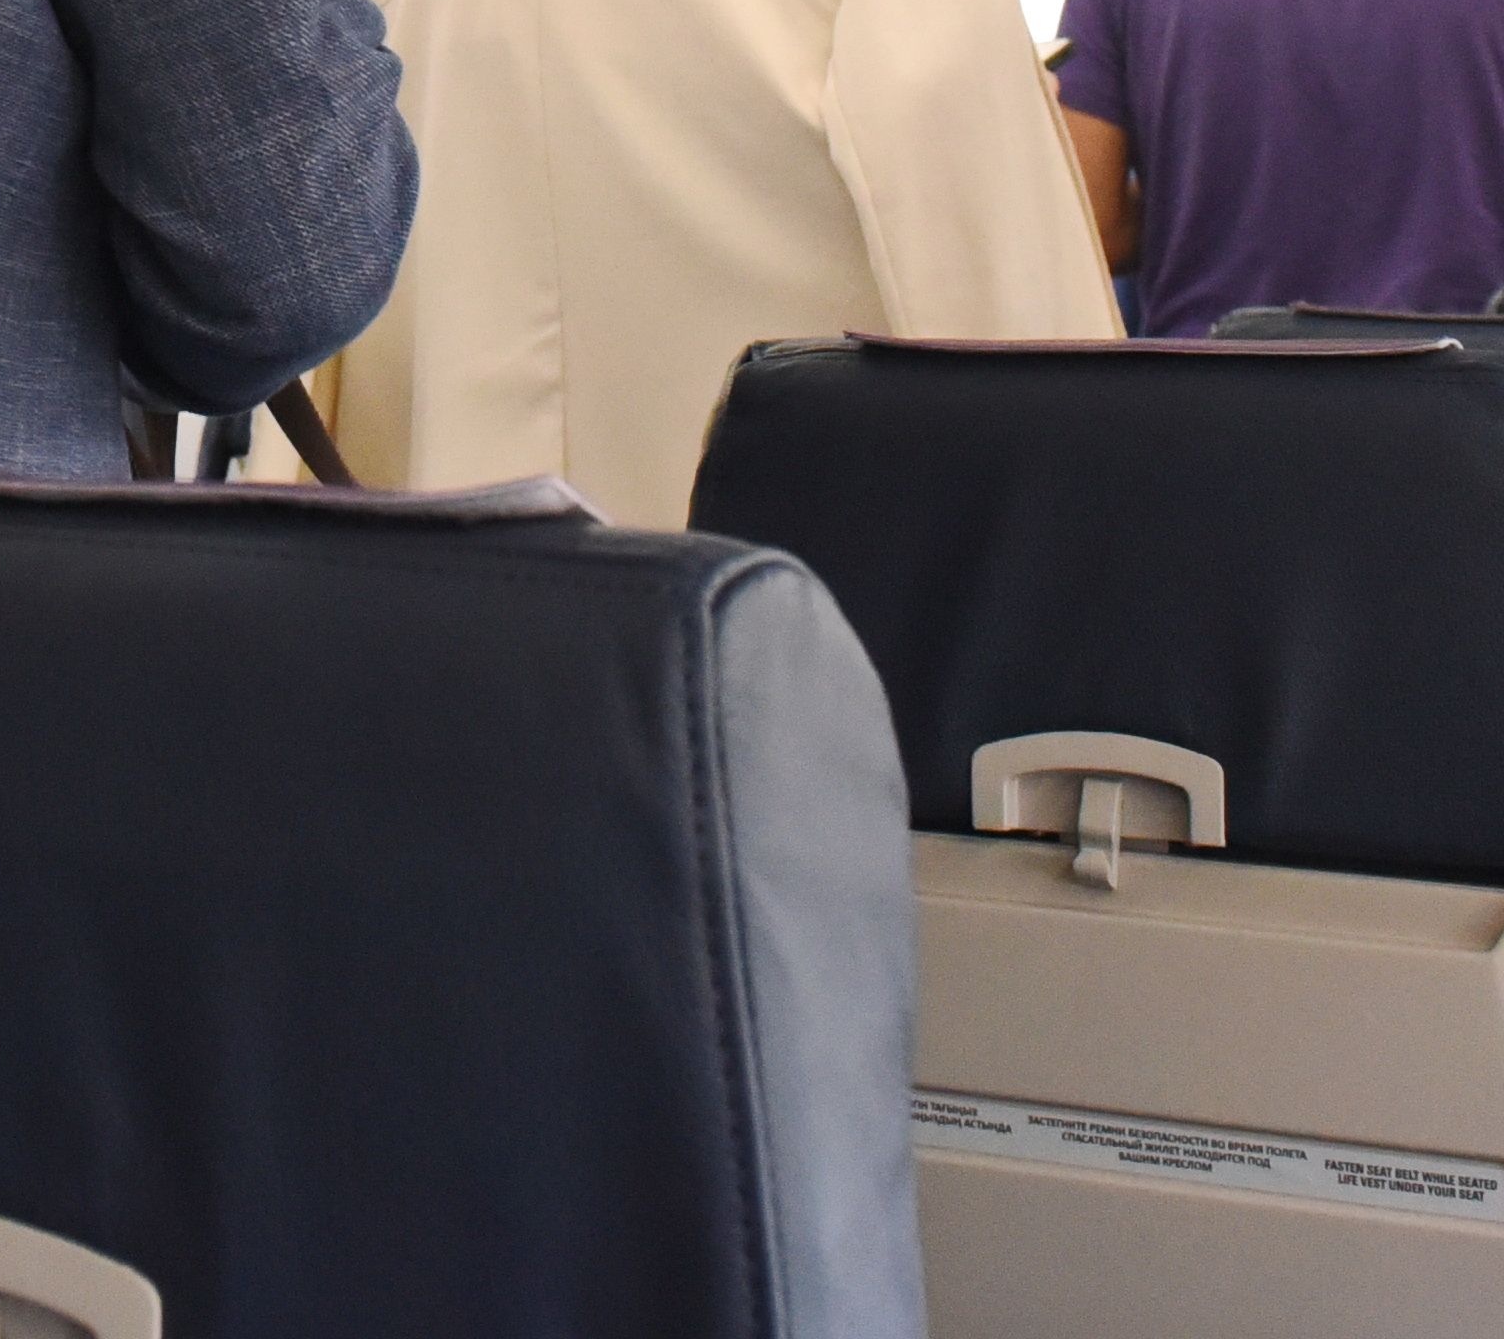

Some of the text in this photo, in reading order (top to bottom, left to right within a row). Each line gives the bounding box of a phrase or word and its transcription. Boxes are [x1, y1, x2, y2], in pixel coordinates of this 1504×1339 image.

[1028, 1115, 1308, 1160] ЗАСТЕГНИТЕ РЕМНИ БЕЗОПАСНОСТИ ВО ВРЕМЯ ПОЛЕТА
[1061, 1131, 1271, 1169] СПАСАТЕЛЬНЫЙ ЖИЛЕТ НАХОДИТСЯ ПОД
[1118, 1151, 1213, 1172] ВАШИМ КРЕСЛОМ
[1324, 1159, 1498, 1190] FASTEN SEAT BELT WHILE SEATED
[1337, 1173, 1485, 1202] LIFE VEST UNDER YOUR SEAT
